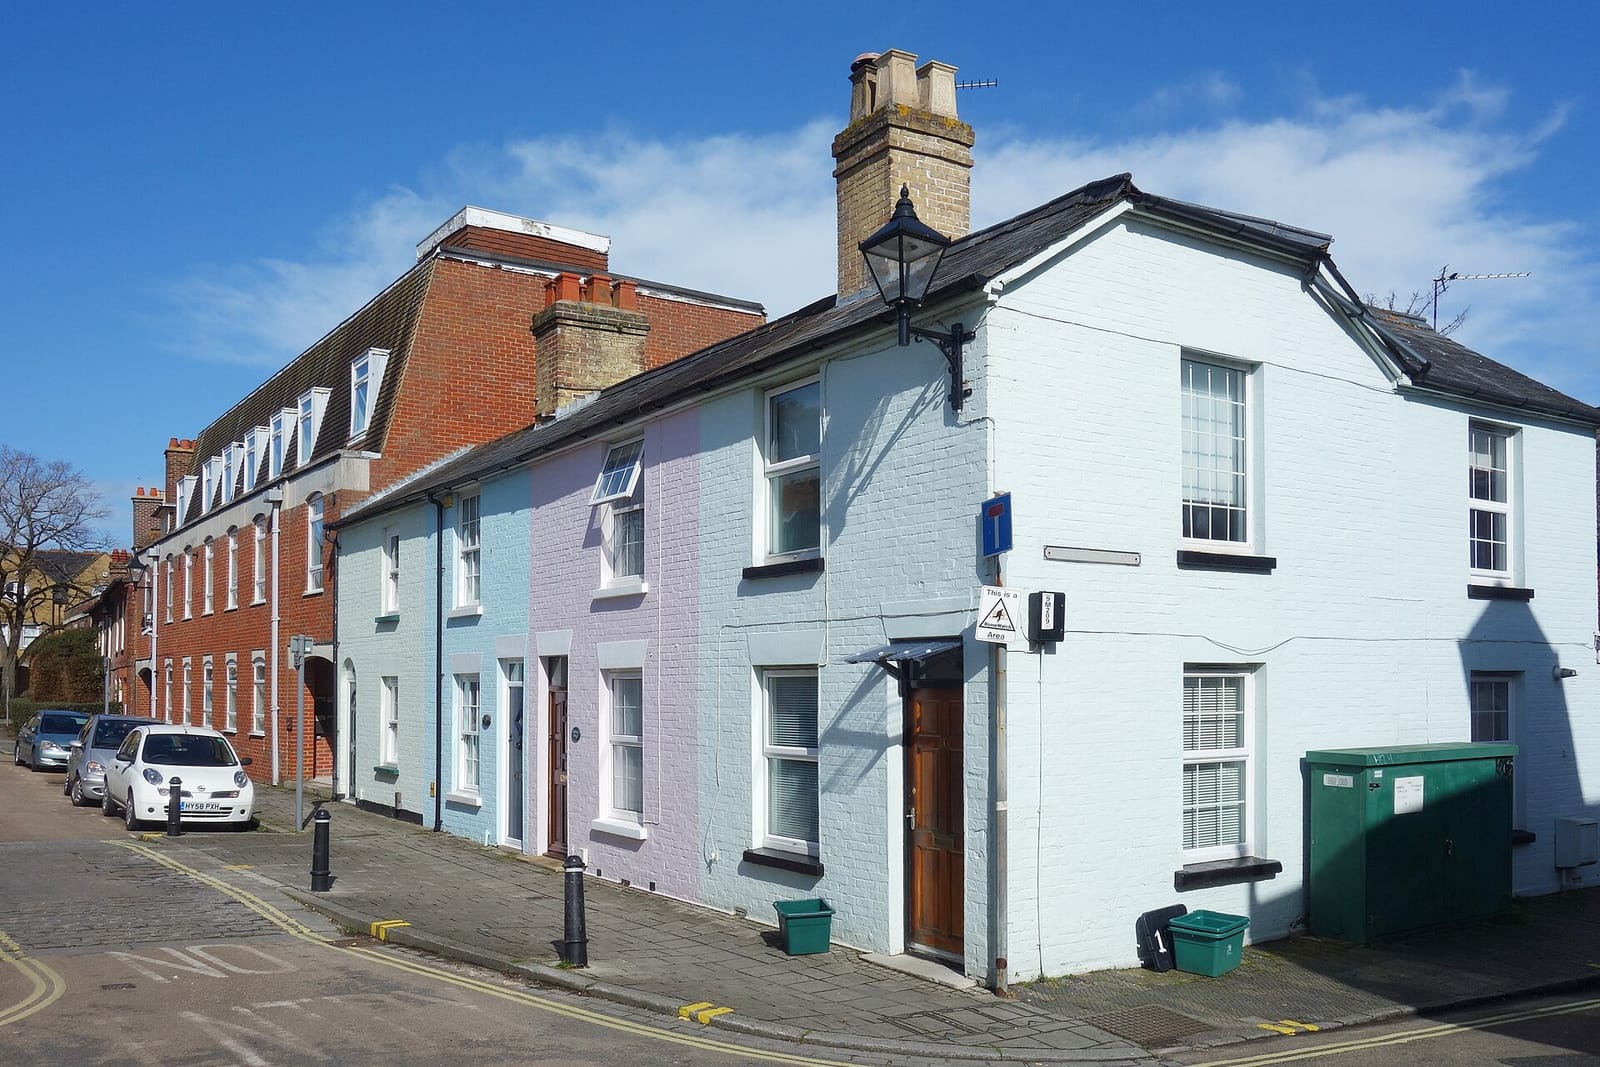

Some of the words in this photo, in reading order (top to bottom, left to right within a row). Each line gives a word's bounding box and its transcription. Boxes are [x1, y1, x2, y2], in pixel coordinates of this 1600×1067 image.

[987, 589, 1002, 597] This
[987, 632, 1005, 640] Area
[1154, 929, 1167, 953] 1
[104, 944, 297, 984] NO
